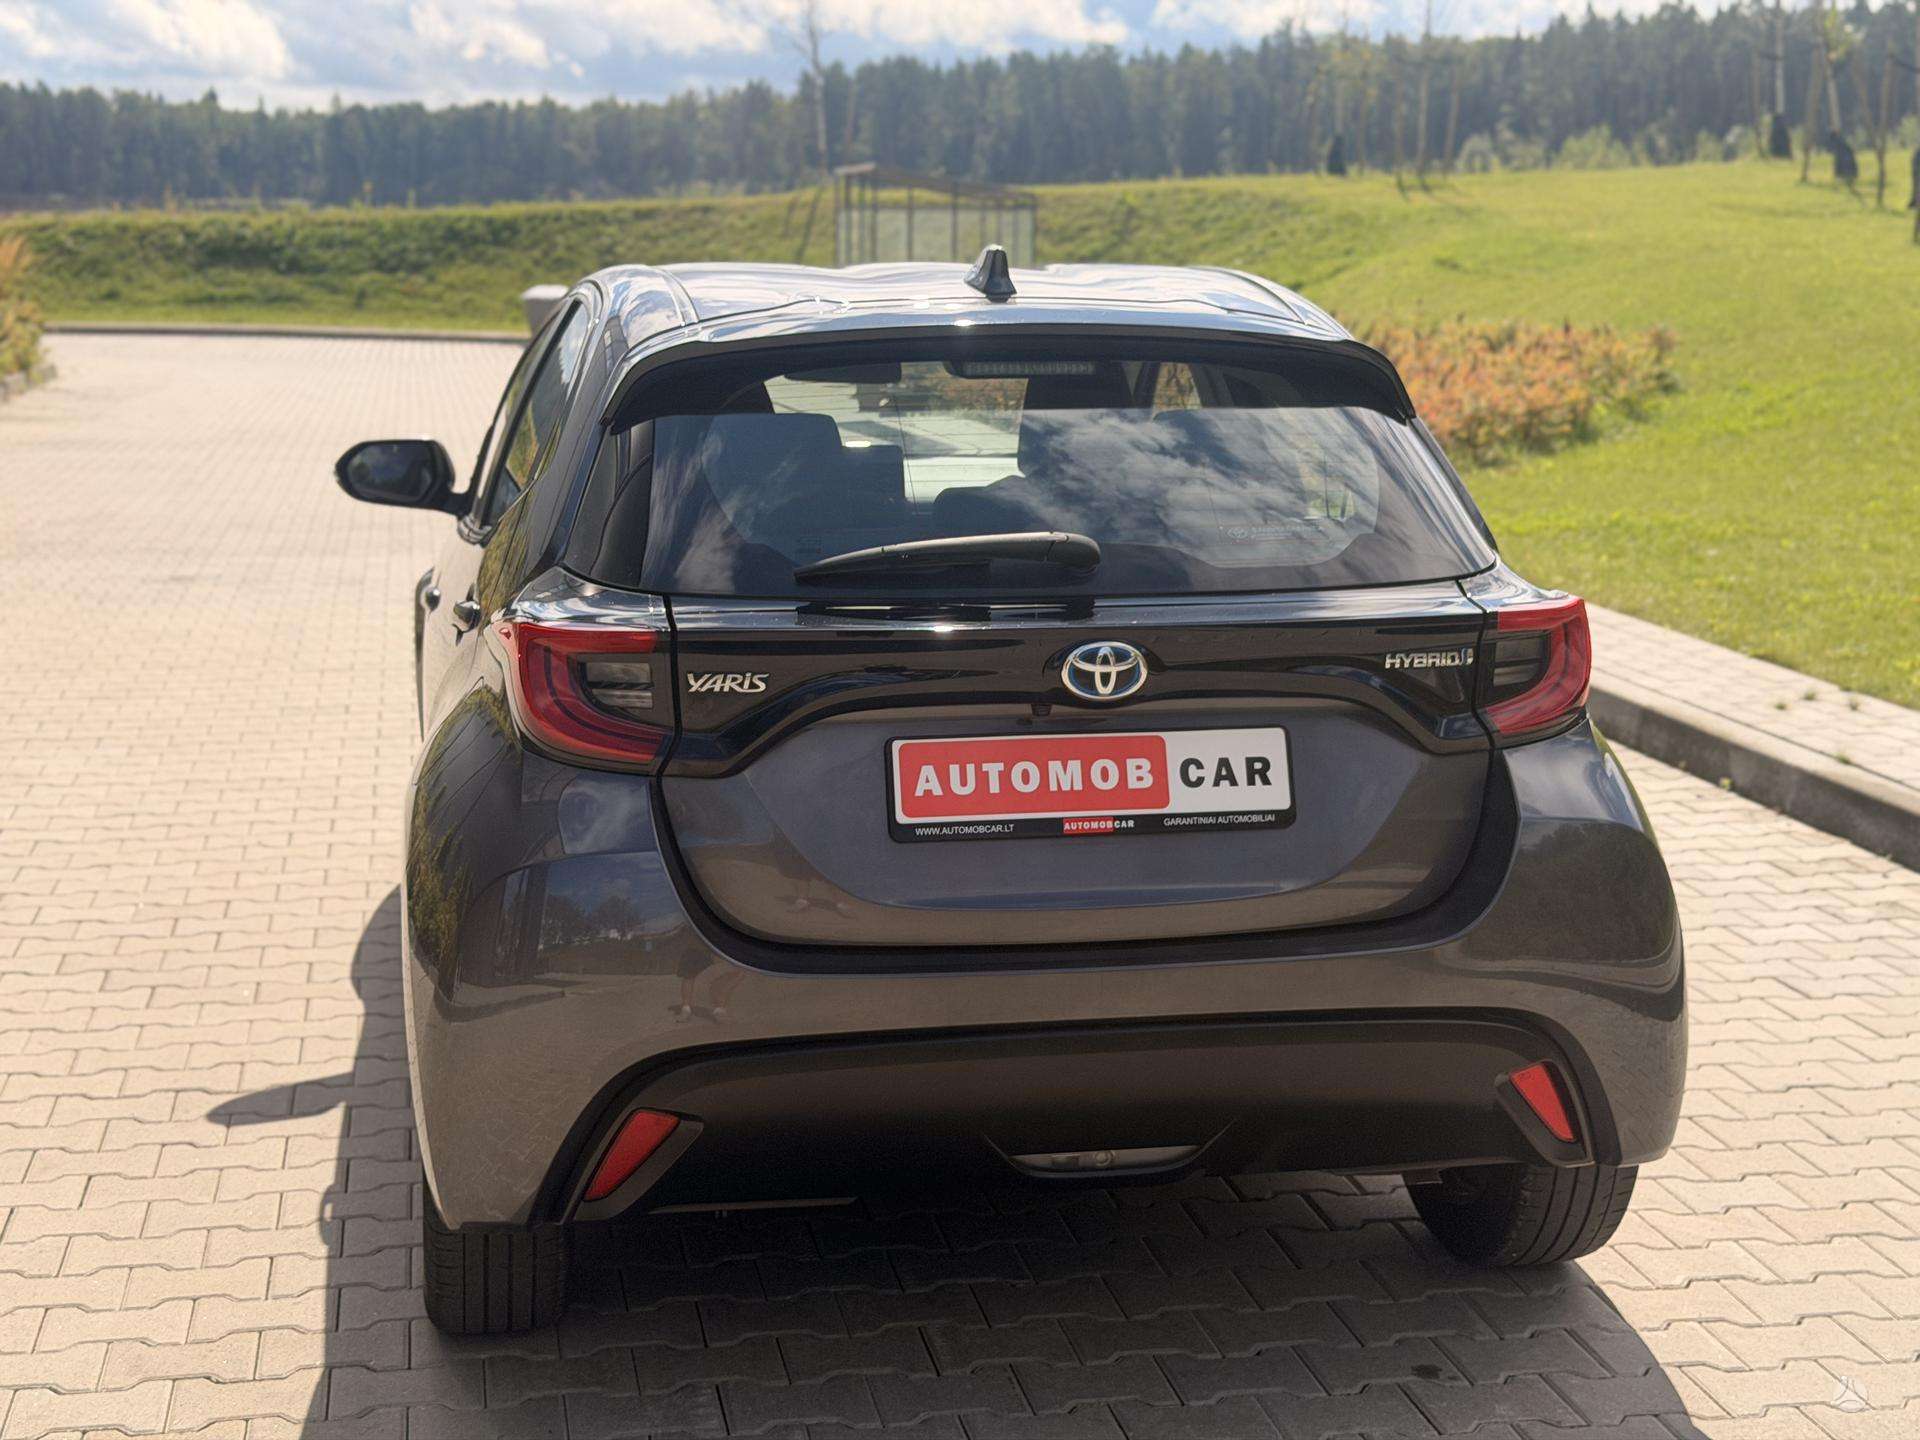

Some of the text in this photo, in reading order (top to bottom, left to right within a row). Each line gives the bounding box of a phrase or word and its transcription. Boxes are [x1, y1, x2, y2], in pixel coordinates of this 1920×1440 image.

[1384, 652, 1460, 669] HYBRID
[915, 757, 1273, 796] AUTOMOB CAR
[1163, 814, 1275, 826] GARANTINIAI AUTOMOBILIAI
[915, 824, 1014, 836] WWW.AUTOMOBCAR.LT
